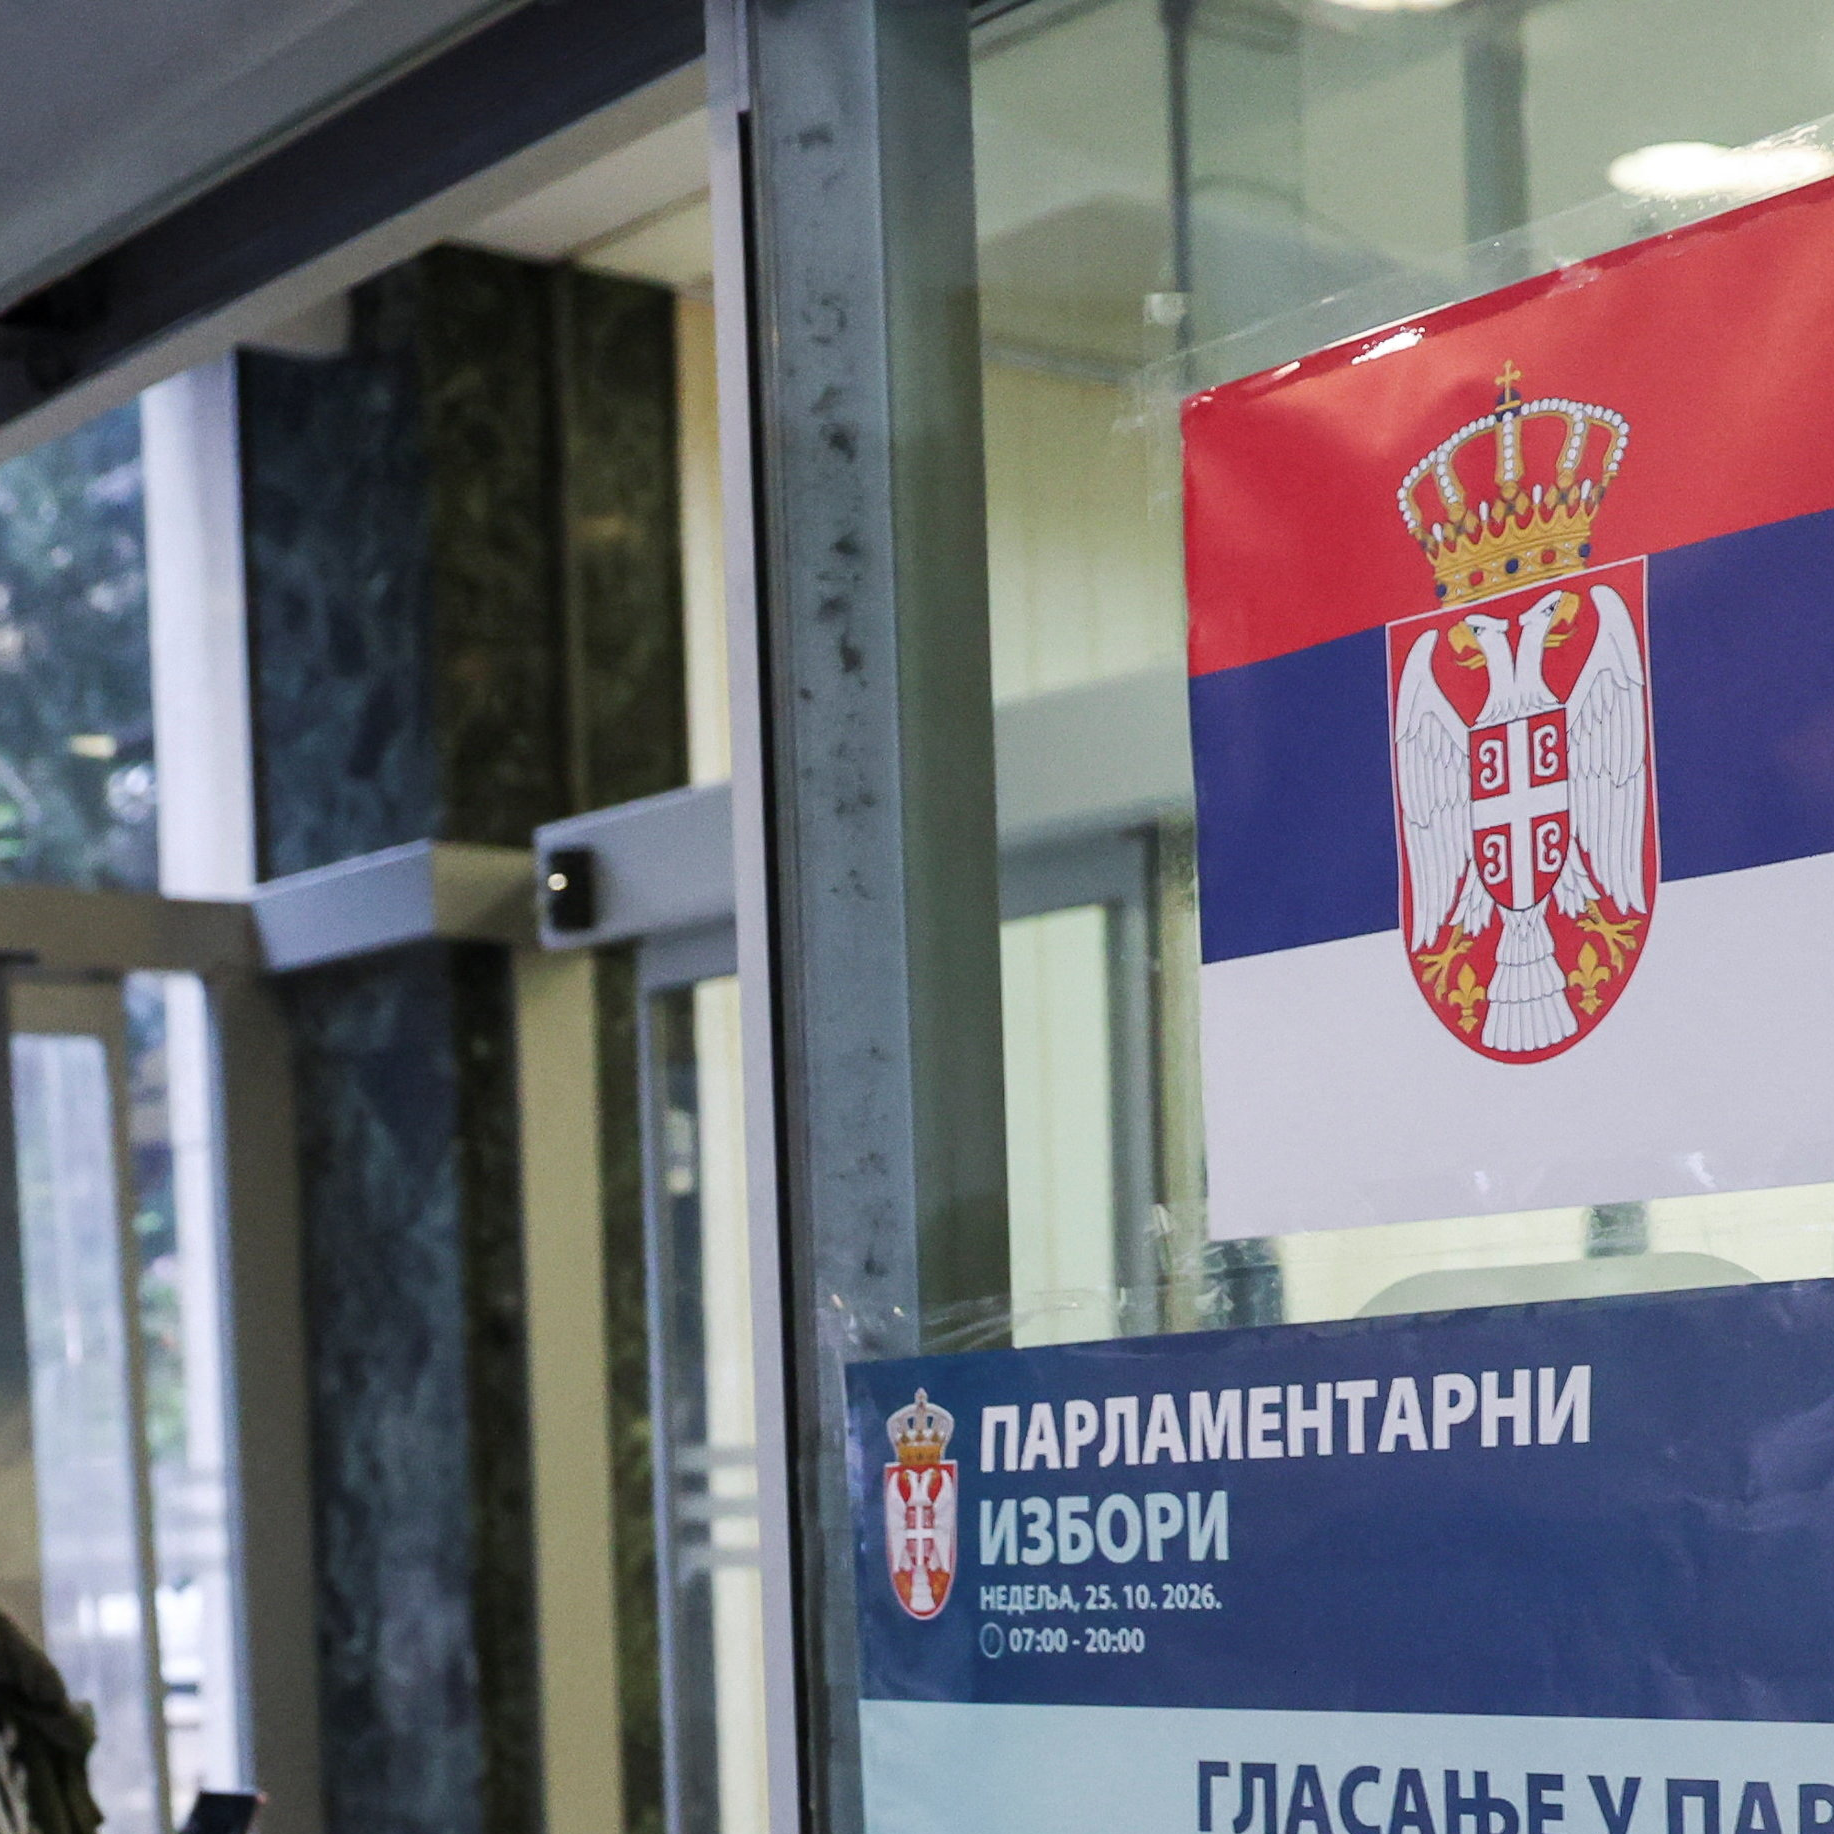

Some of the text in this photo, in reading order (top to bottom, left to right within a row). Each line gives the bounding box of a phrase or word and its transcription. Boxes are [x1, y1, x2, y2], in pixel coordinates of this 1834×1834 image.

[980, 1365, 1591, 1472] ПАРЛАМЕНТАРНИ
[979, 1490, 1229, 1566] ИЗБОРИ
[980, 1583, 1222, 1614] НЕДЕЉА, 25. 10. 2026.
[1009, 1628, 1067, 1654] 07:00
[1085, 1628, 1145, 1653] 20:00
